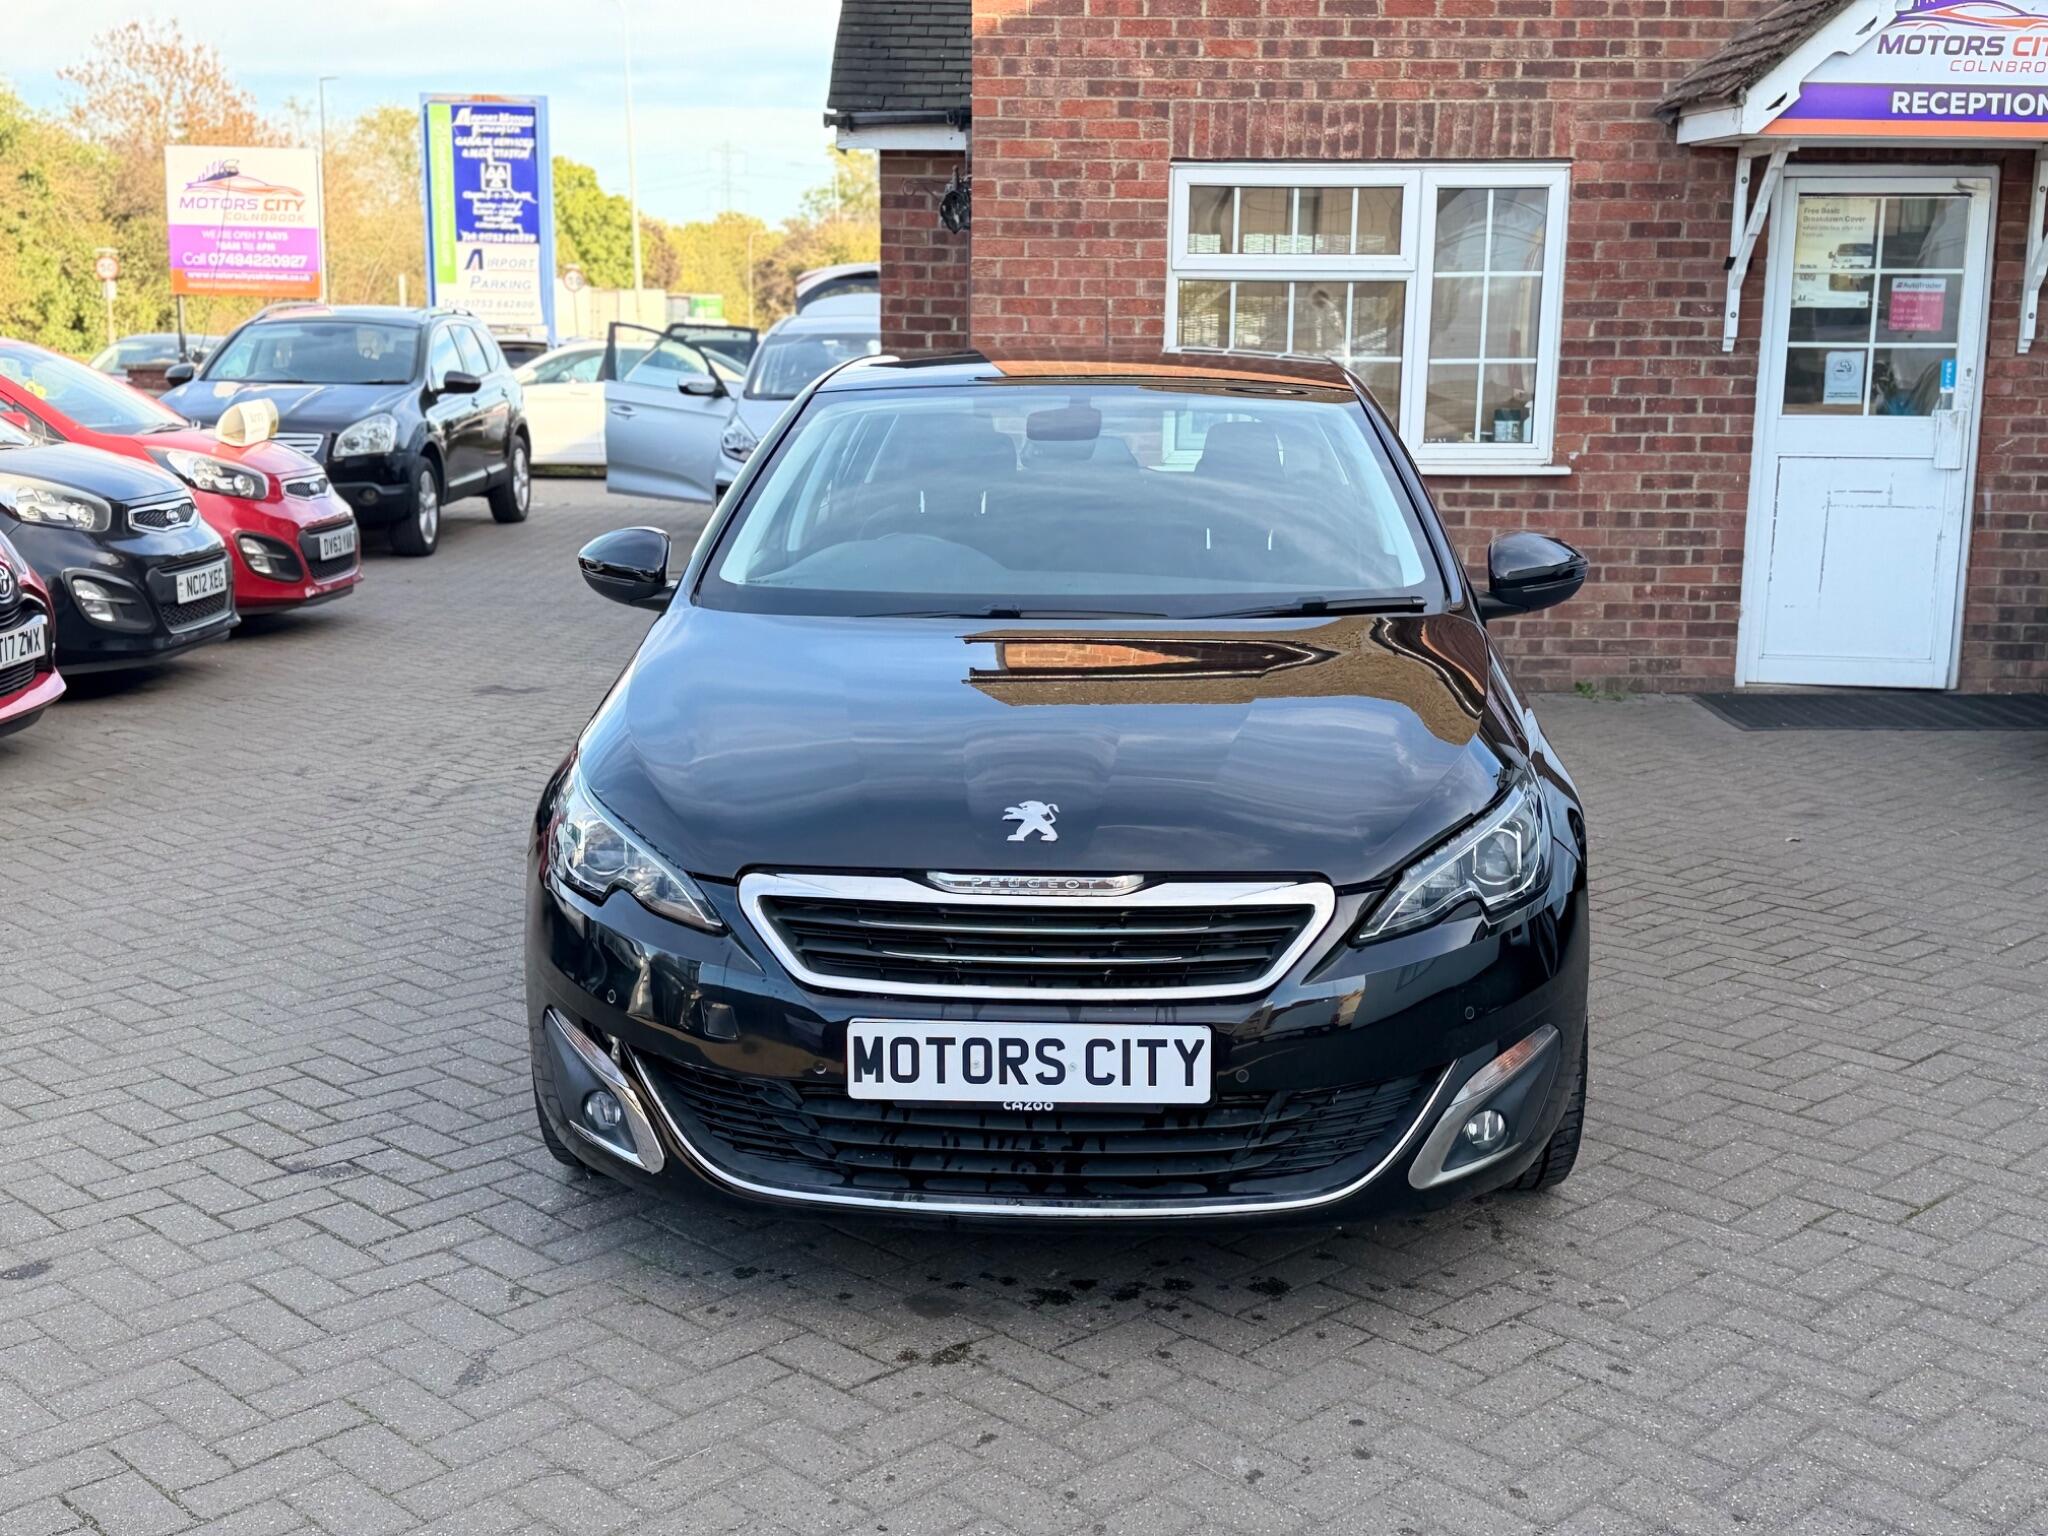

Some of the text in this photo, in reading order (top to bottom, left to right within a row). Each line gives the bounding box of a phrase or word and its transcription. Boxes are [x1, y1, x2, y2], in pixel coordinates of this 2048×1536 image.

[1877, 34, 2006, 56] MOTORS
[180, 197, 305, 212] MOTORS CITY
[1844, 215, 1866, 223] Cover
[182, 251, 207, 265] Call
[470, 275, 532, 289] PARKING
[186, 567, 224, 598] NC12 XEG
[18, 627, 41, 657] ZWX
[971, 876, 1097, 889] PEUGEOT
[853, 1036, 1205, 1087] MOTORS CITY
[1003, 1100, 1055, 1111] CAZOO
